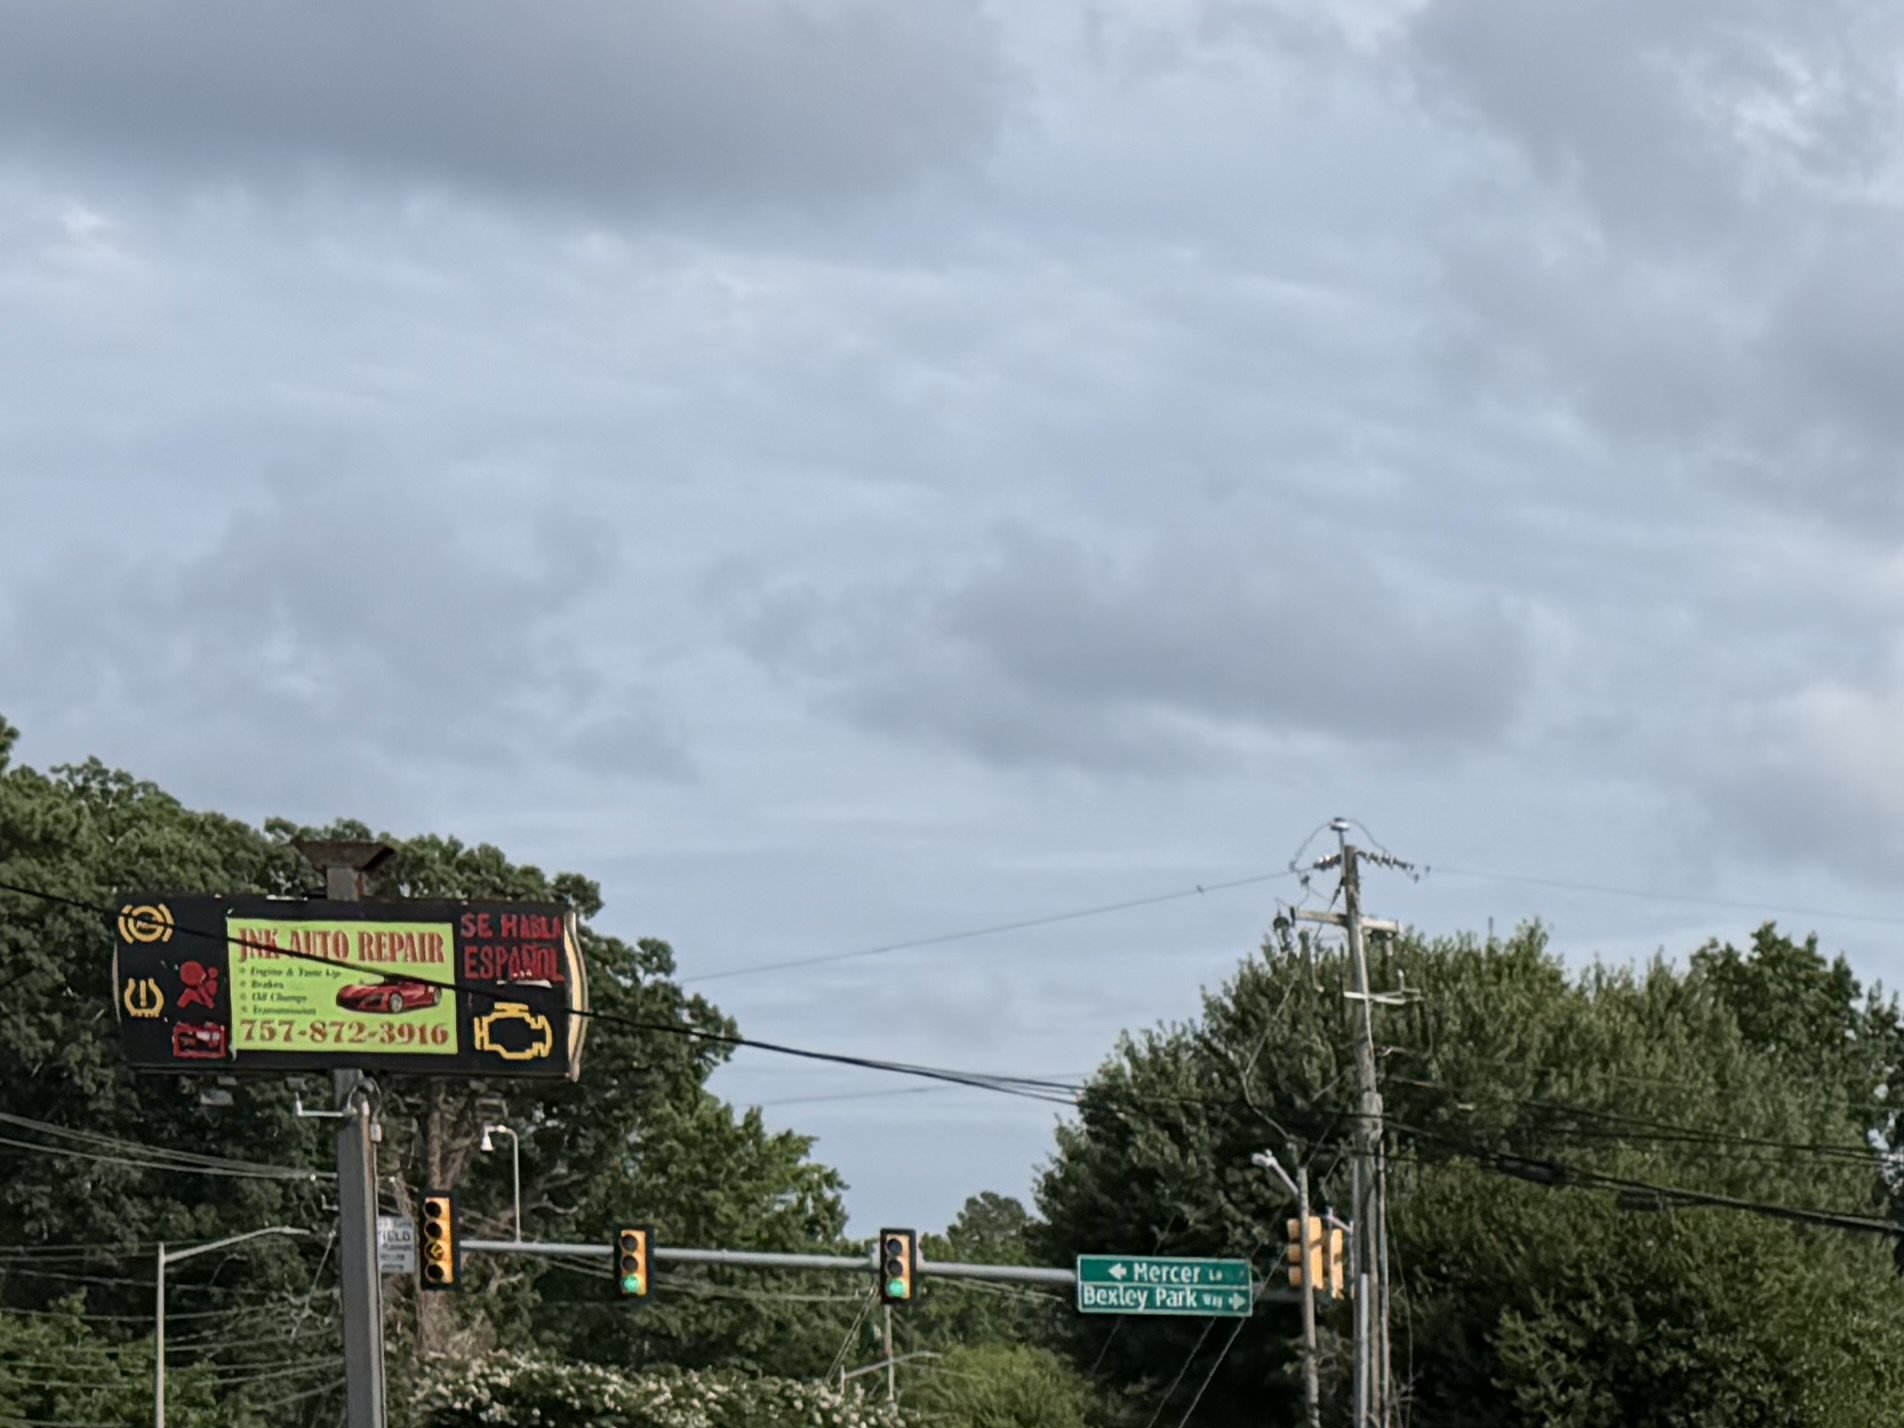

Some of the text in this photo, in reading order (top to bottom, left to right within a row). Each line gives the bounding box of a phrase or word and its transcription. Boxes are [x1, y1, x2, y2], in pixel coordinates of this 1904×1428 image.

[461, 912, 492, 938] SE
[238, 927, 445, 963] JNK AUTO REPAIR
[240, 1019, 449, 1046] 757-872-3916
[1133, 1262, 1201, 1283] Mercer
[1083, 1286, 1149, 1311] Bexley
[1155, 1287, 1198, 1308] Park
